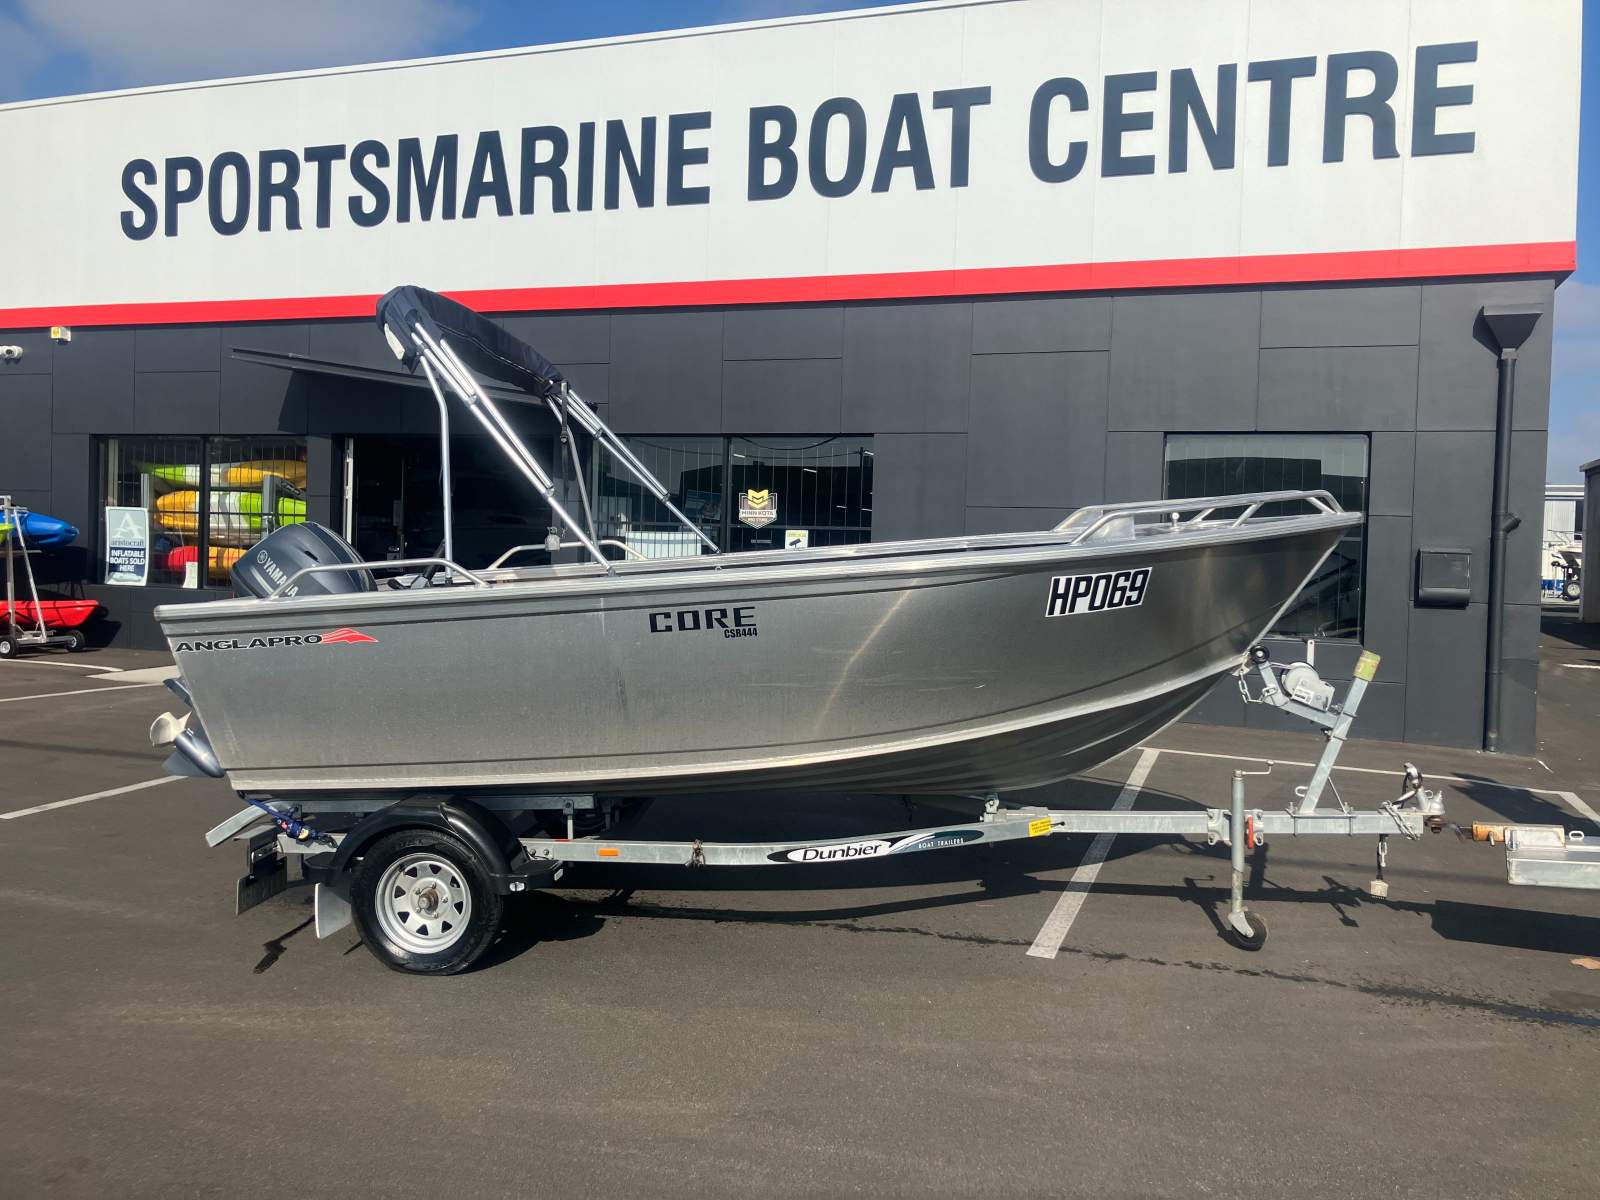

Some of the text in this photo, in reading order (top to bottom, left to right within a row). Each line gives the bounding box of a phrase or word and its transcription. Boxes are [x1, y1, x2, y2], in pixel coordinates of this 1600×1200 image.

[120, 40, 1479, 241] SPORTSMARINE BOAT CENTRE
[109, 557, 145, 566] BOATS SOLD
[111, 549, 145, 558] INFLATABLE
[119, 564, 135, 572] HERE
[263, 557, 299, 597] YAMAA
[1047, 569, 1150, 616] HP069
[649, 606, 757, 633] CORE
[175, 633, 323, 653] ANGLAPRO
[802, 843, 882, 861] Dunbier
[918, 837, 964, 849] BOAT TRAILERS
